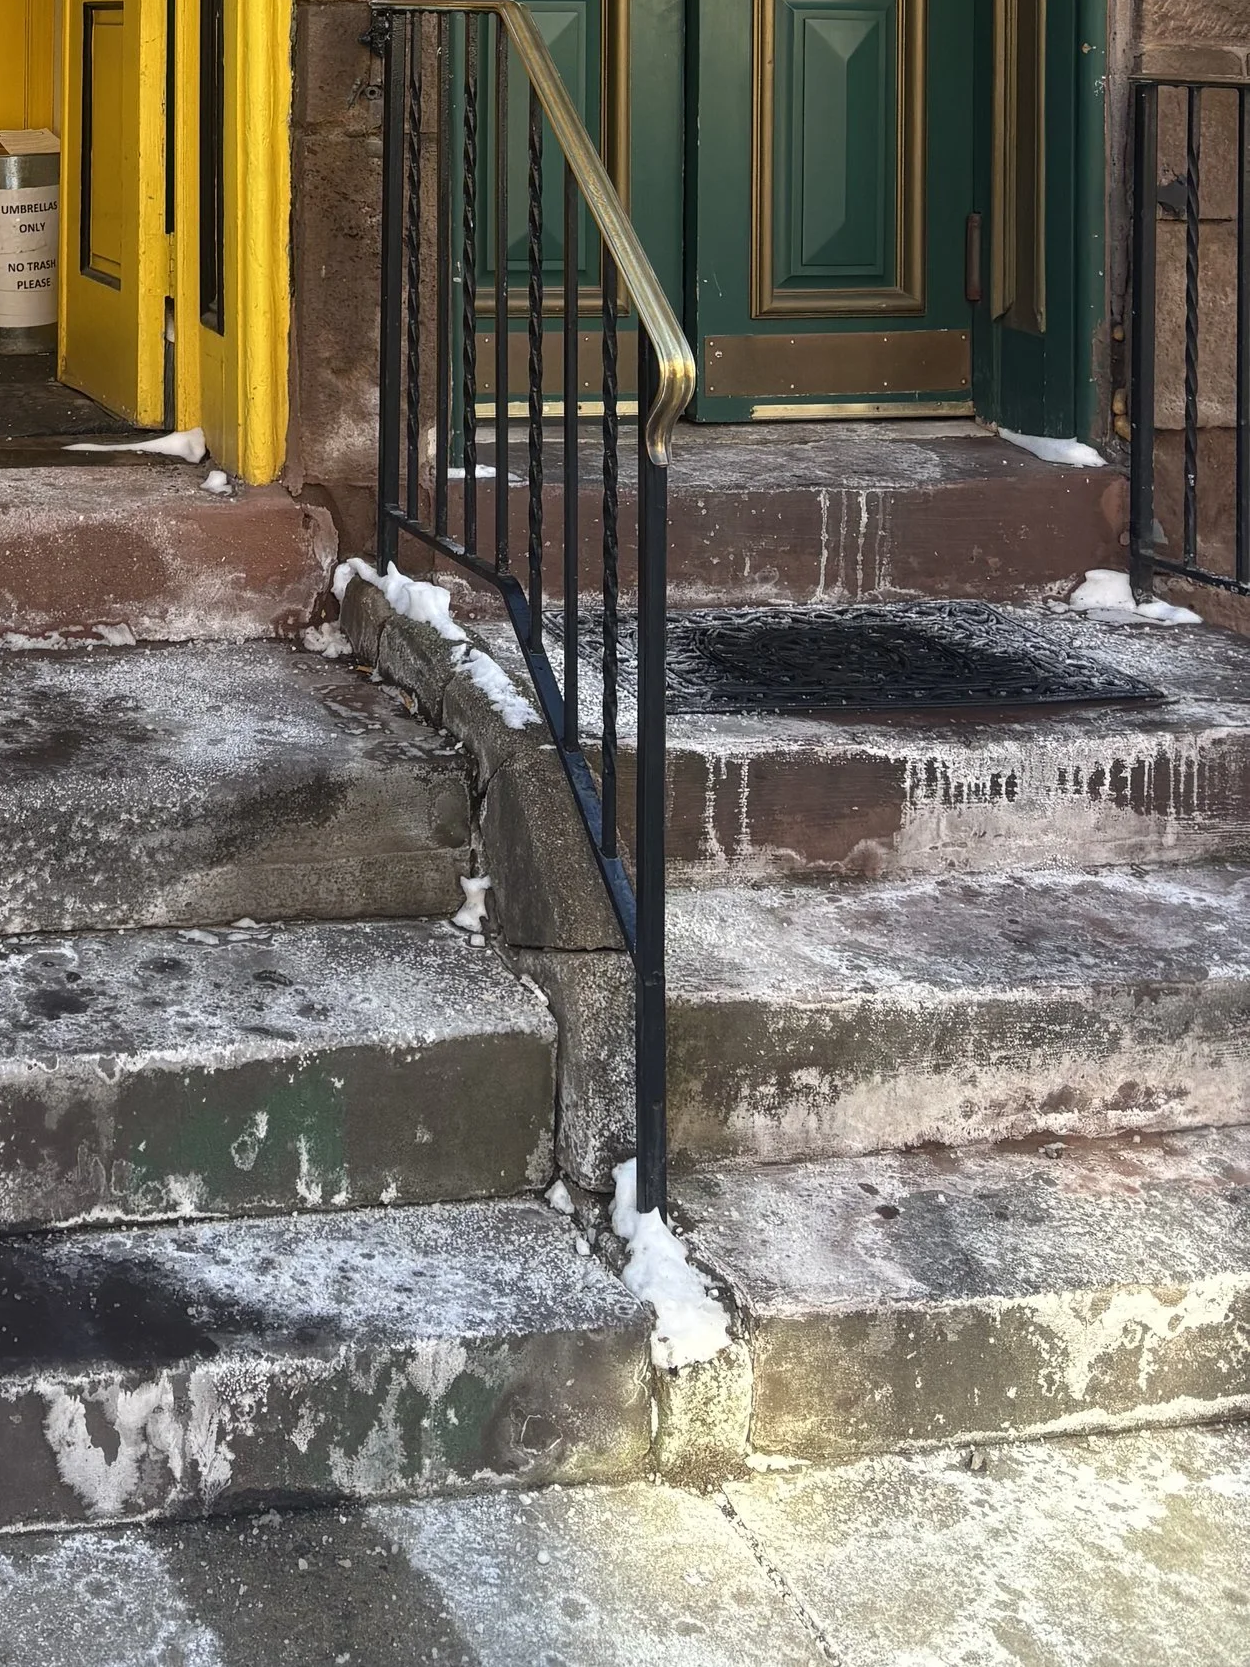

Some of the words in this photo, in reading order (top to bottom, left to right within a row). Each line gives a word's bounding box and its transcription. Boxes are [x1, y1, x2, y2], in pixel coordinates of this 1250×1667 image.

[0, 200, 58, 215] UMBRELLAS
[19, 222, 46, 234] ONLY
[7, 262, 25, 273] NO
[26, 258, 57, 272] TRASH
[17, 277, 52, 290] PLEASE
